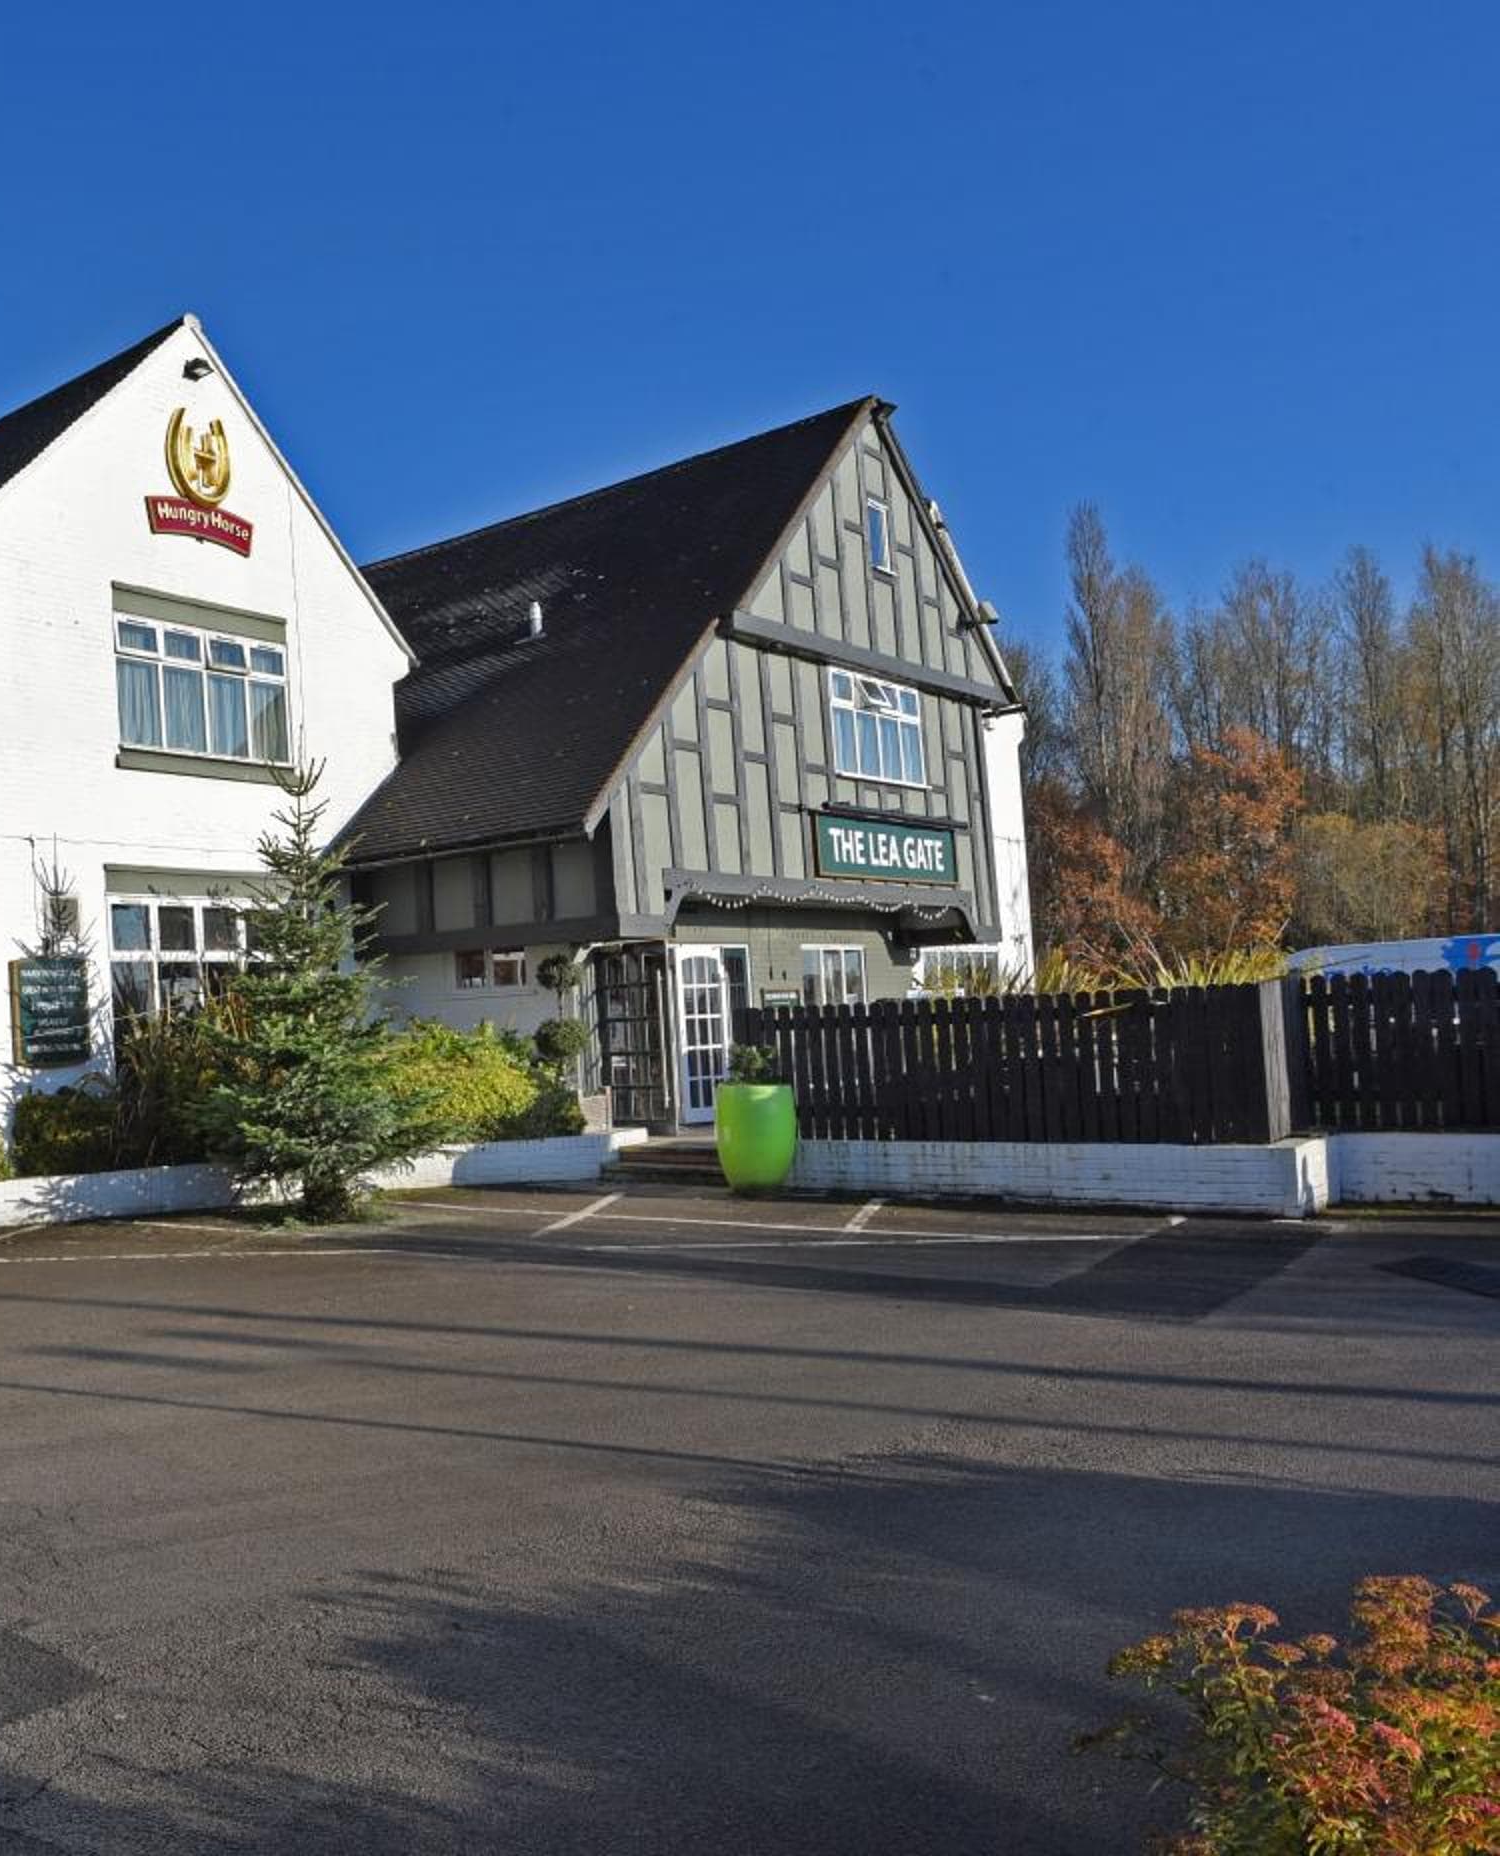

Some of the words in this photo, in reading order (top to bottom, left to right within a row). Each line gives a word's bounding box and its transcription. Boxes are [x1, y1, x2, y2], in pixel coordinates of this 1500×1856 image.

[157, 502, 209, 528] Hungry
[211, 511, 249, 540] Horse
[828, 827, 866, 864] THE
[868, 832, 901, 868] LEA
[904, 837, 945, 872] GATE
